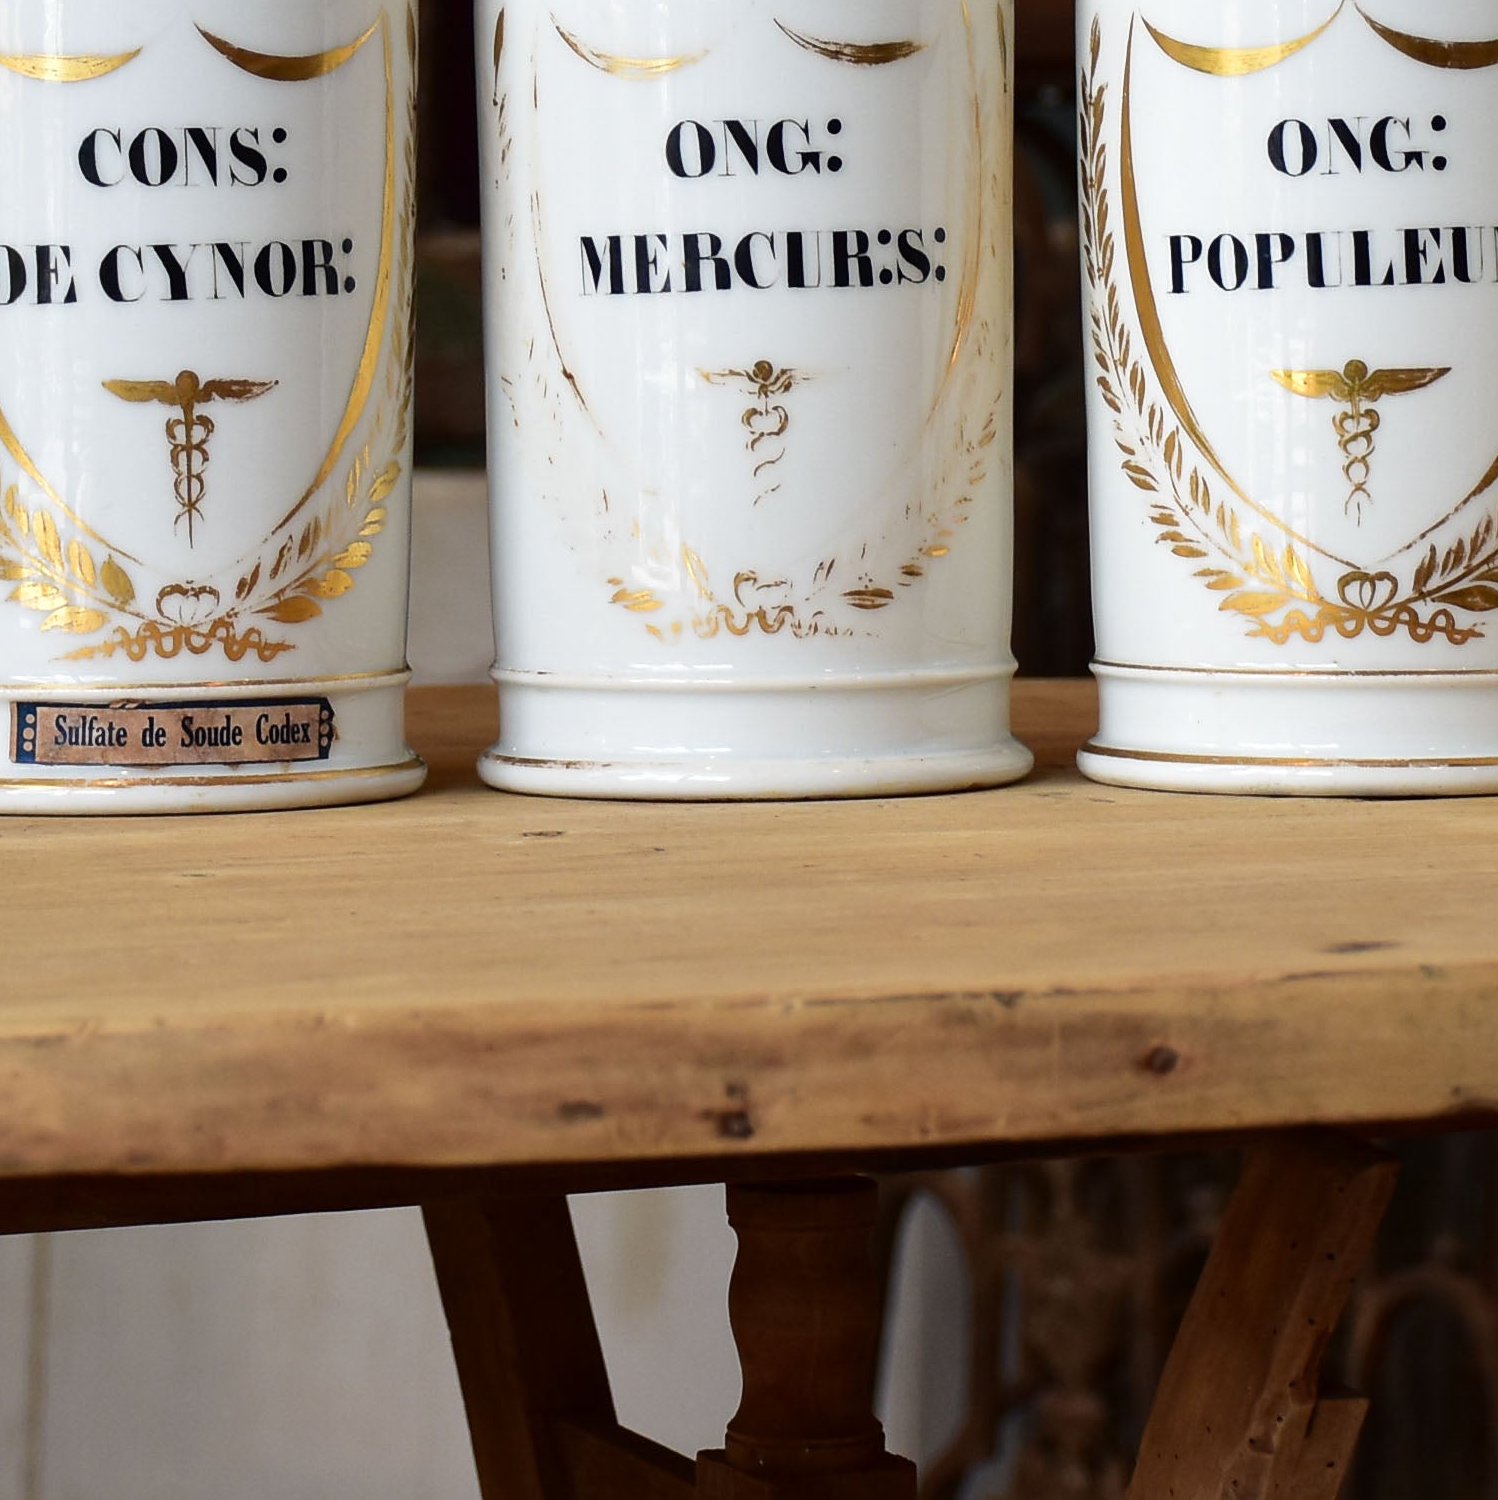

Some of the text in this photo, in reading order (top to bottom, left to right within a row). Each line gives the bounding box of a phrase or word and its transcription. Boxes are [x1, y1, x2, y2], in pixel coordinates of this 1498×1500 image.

[76, 126, 289, 189] CONS:
[664, 117, 844, 179] ONG:
[1266, 114, 1449, 178] ONG:
[98, 236, 357, 304] CYNOR:
[54, 712, 312, 748] Sulfate de Soude Codex
